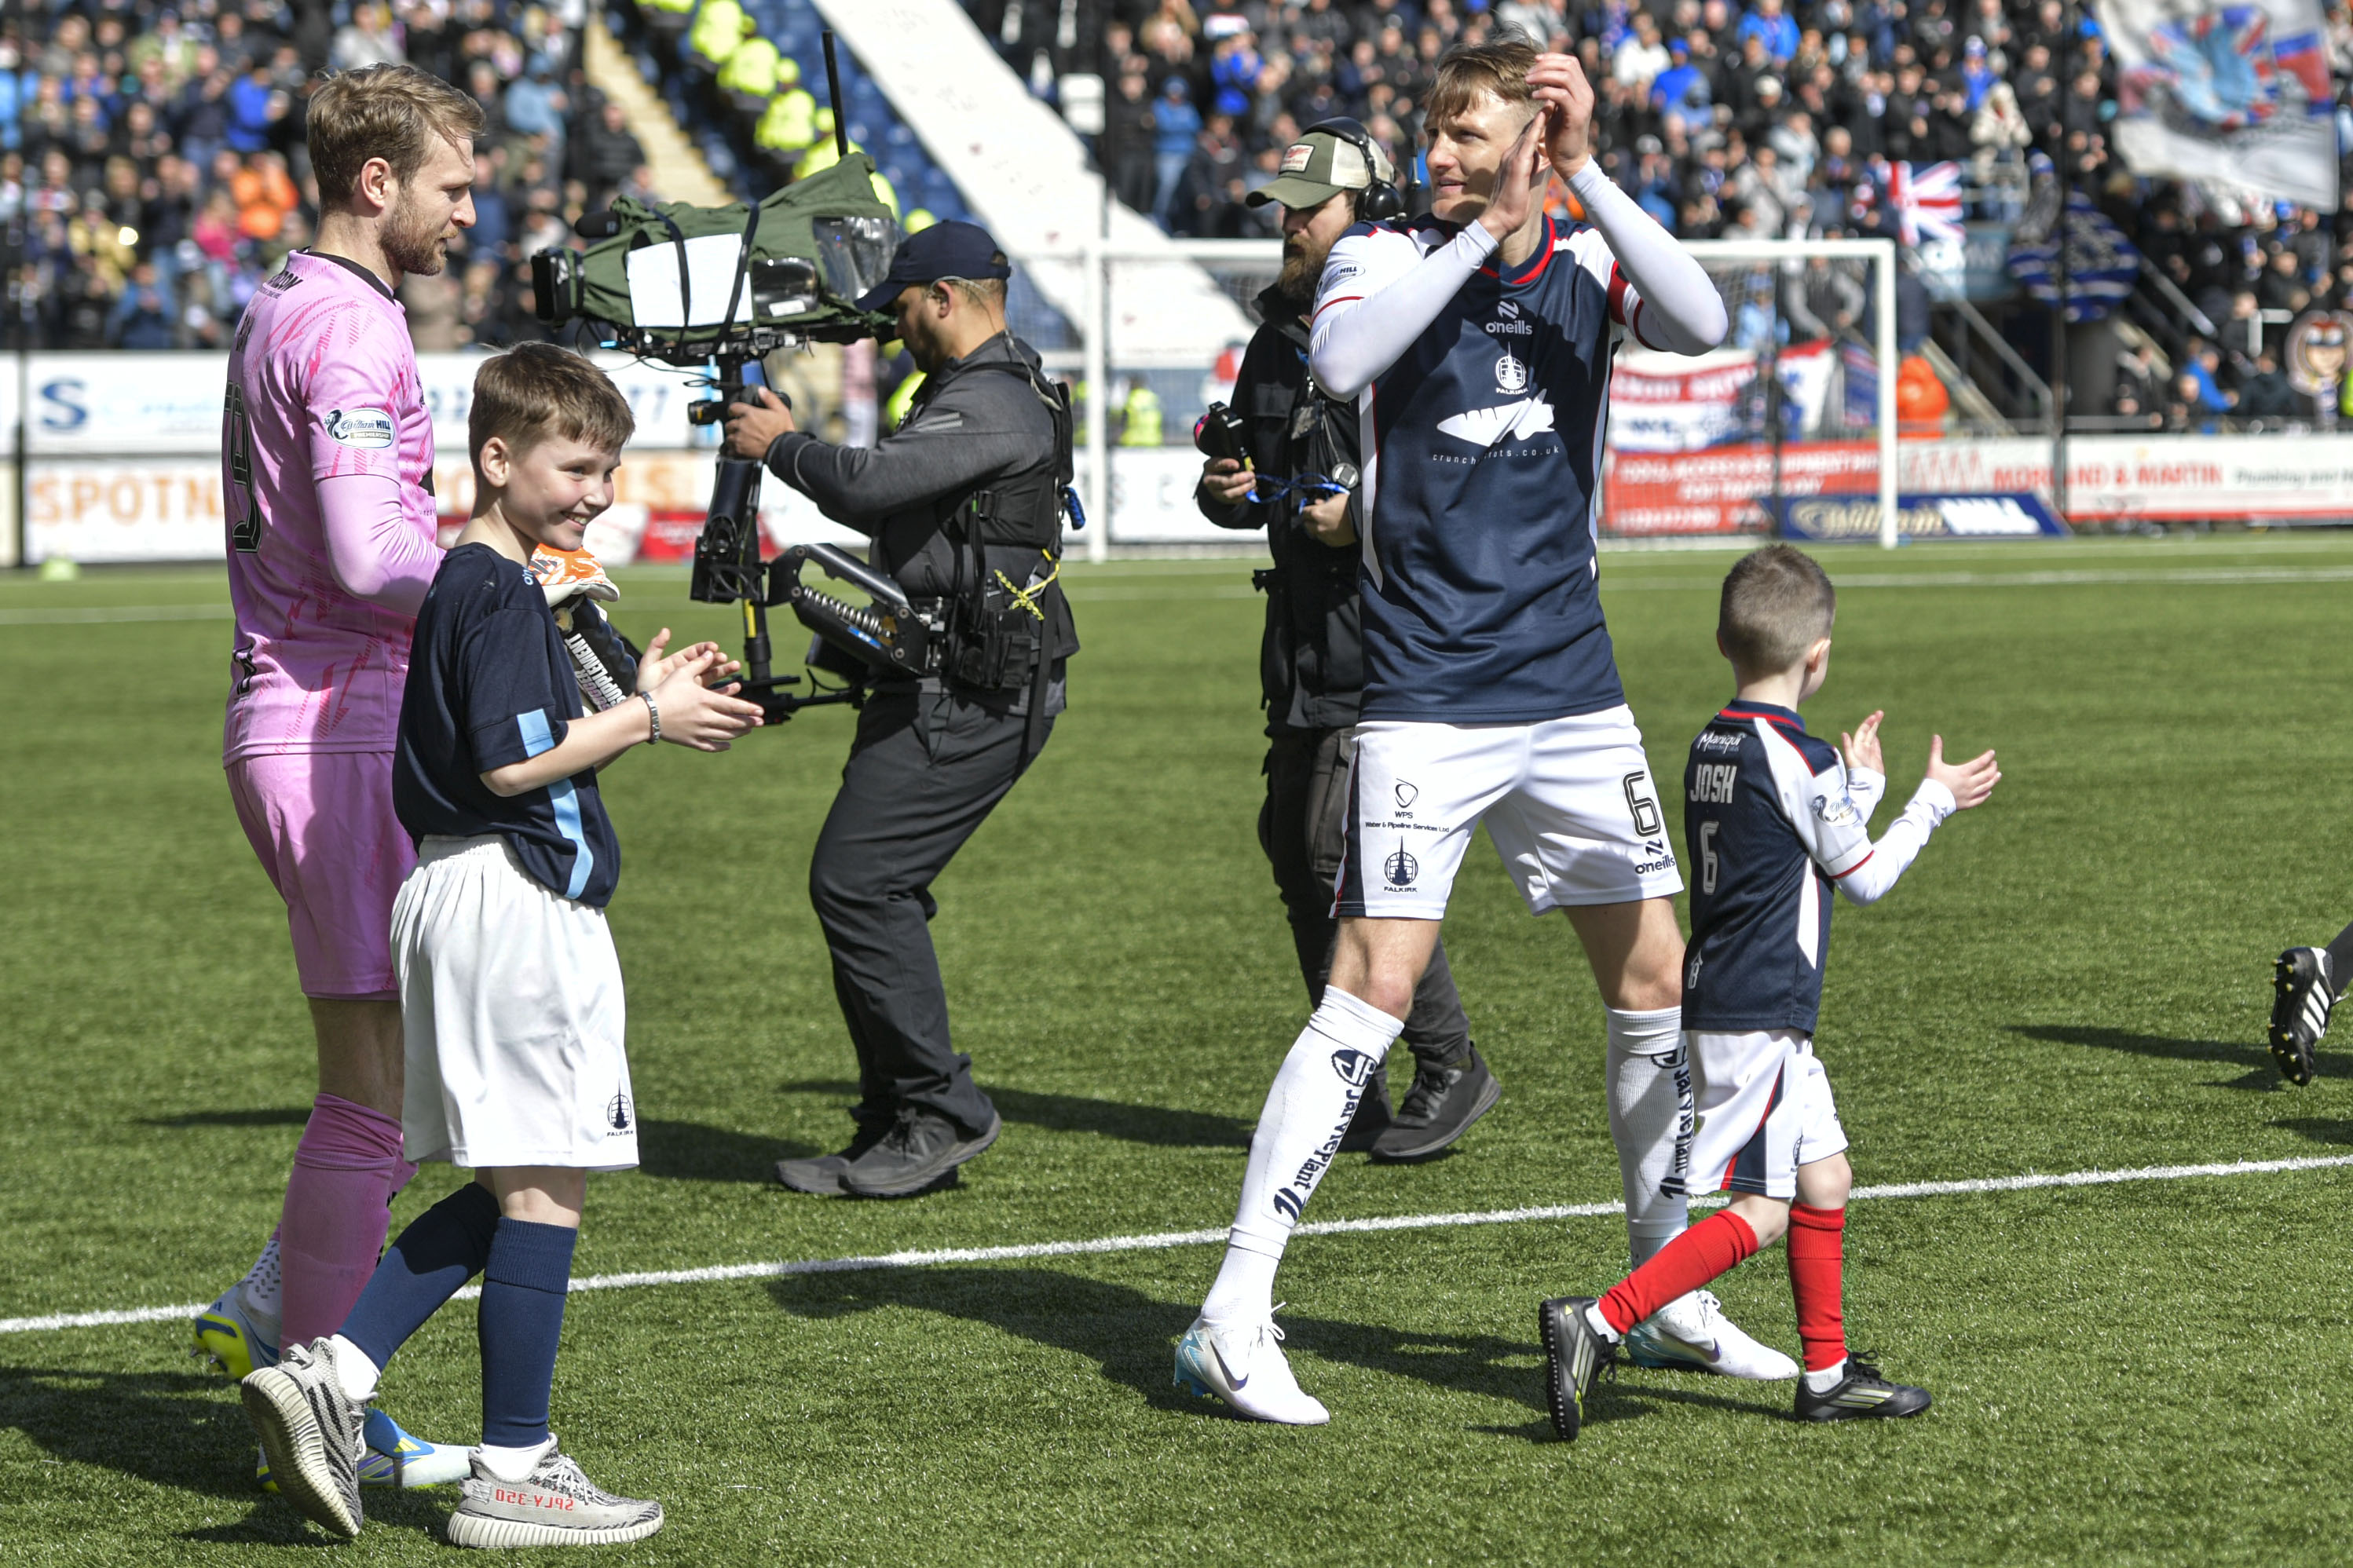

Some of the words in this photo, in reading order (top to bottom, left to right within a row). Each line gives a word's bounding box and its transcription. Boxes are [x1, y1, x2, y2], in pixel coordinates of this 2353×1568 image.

[1486, 320, 1532, 335] o'neills
[341, 418, 375, 430] William
[376, 419, 391, 429] HILL
[1690, 763, 1737, 804] JOSH
[1622, 769, 1661, 838] 6
[1413, 824, 1438, 832] Services
[1634, 854, 1676, 875] o'neills
[1700, 821, 1720, 896] 6
